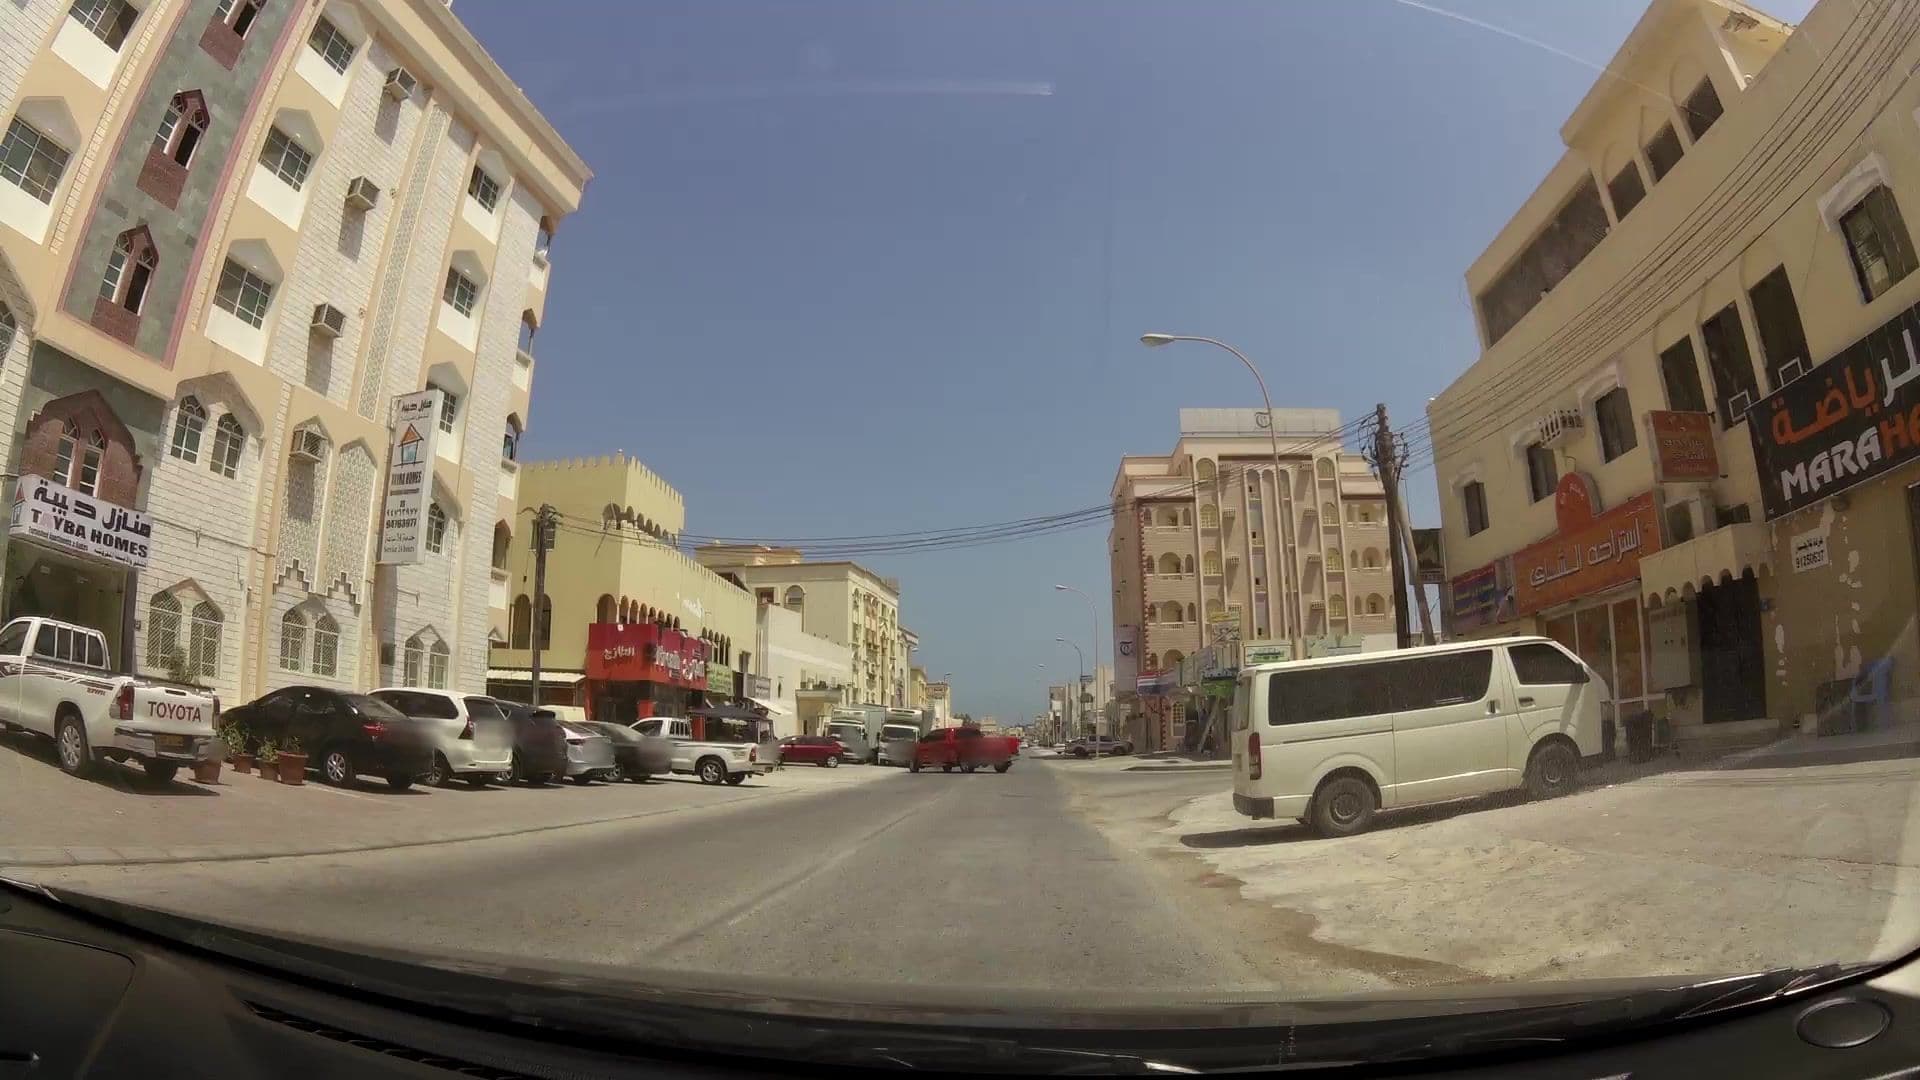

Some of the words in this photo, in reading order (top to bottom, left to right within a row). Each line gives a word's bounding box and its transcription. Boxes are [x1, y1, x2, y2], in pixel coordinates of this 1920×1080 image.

[102, 507, 152, 539] منازل
[90, 528, 149, 558] HOMES
[148, 700, 202, 722] TOYOTA
